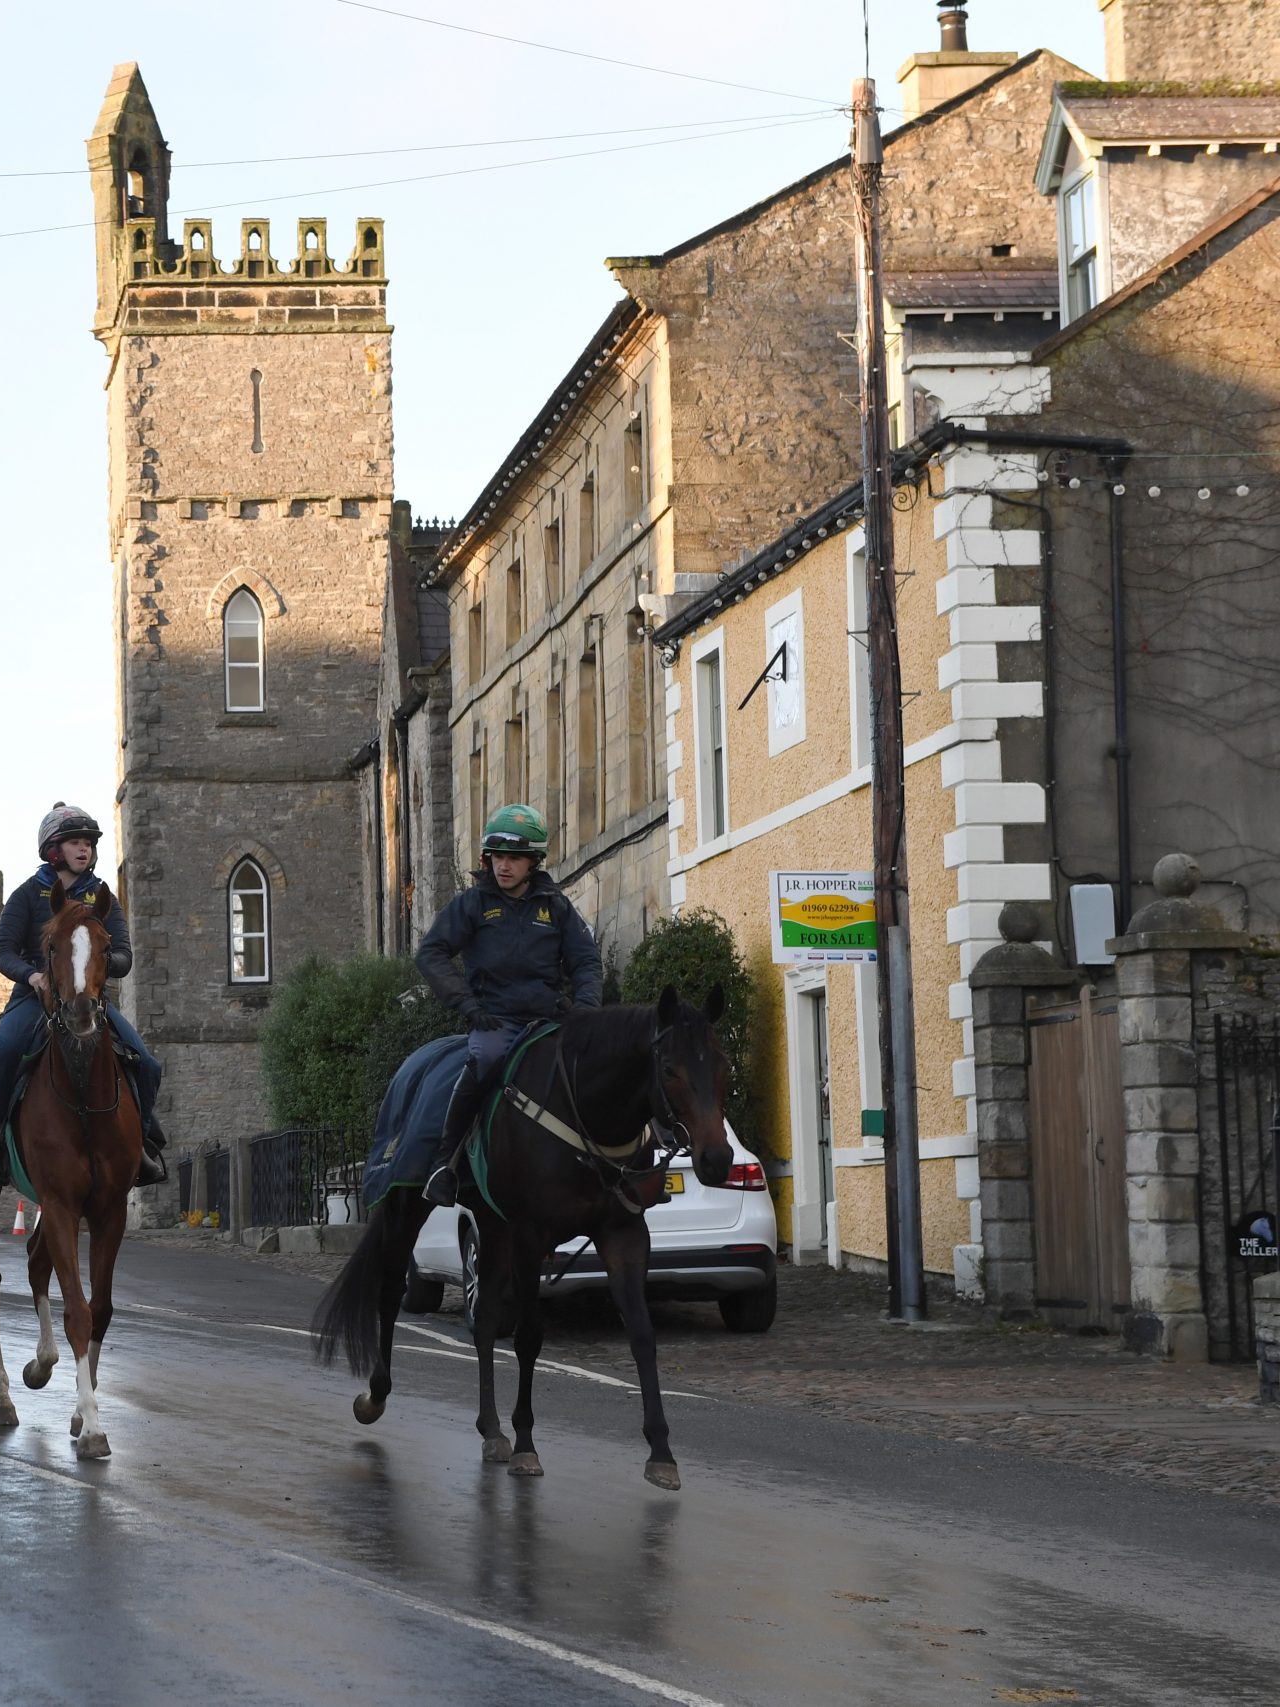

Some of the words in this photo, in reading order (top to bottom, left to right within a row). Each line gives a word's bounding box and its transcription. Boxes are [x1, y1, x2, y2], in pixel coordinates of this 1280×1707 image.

[785, 879, 804, 892] J.R.
[806, 879, 857, 891] HOPPER
[801, 903, 827, 913] 01969
[829, 903, 860, 913] 622936
[800, 933, 828, 945] FOR
[830, 933, 866, 945] SALE
[1239, 1238, 1260, 1247] THE
